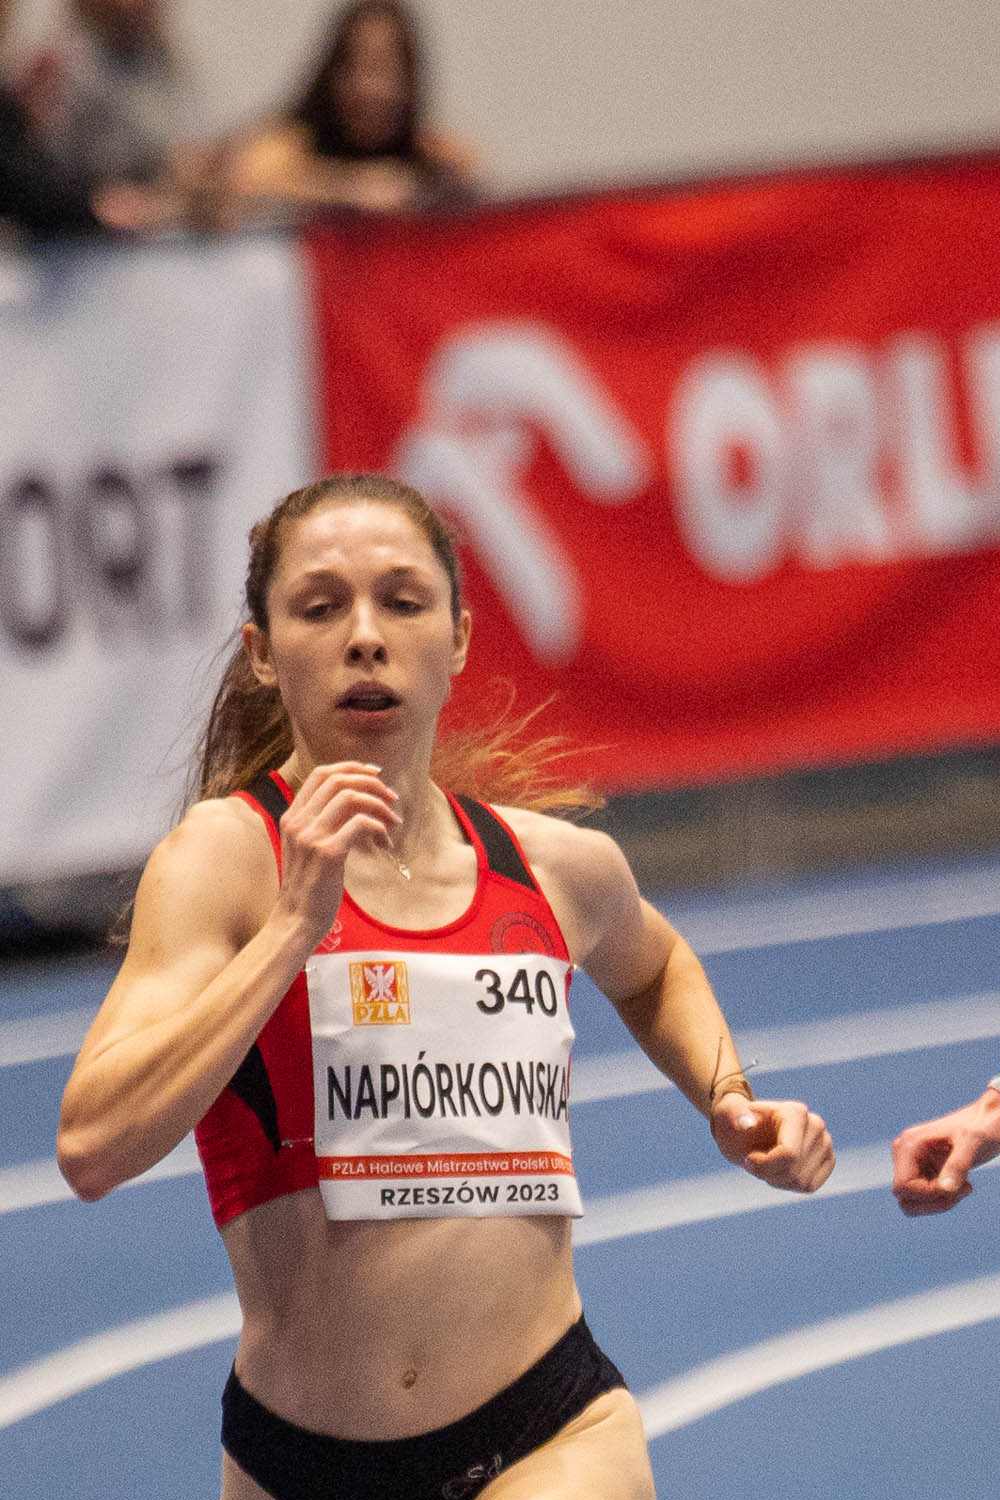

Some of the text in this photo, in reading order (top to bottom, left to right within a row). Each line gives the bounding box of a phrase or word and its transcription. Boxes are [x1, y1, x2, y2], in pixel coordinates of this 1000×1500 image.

[475, 968, 558, 1017] 340
[356, 1003, 408, 1022] PZLA
[326, 1050, 569, 1122] NAPIÓRKOWSKA
[332, 1161, 366, 1176] PZLA
[370, 1161, 424, 1175] Halowe
[427, 1159, 509, 1174] Mistrzostwa
[512, 1157, 549, 1170] Polski
[380, 1181, 559, 1206] RZESZÓW 2023
